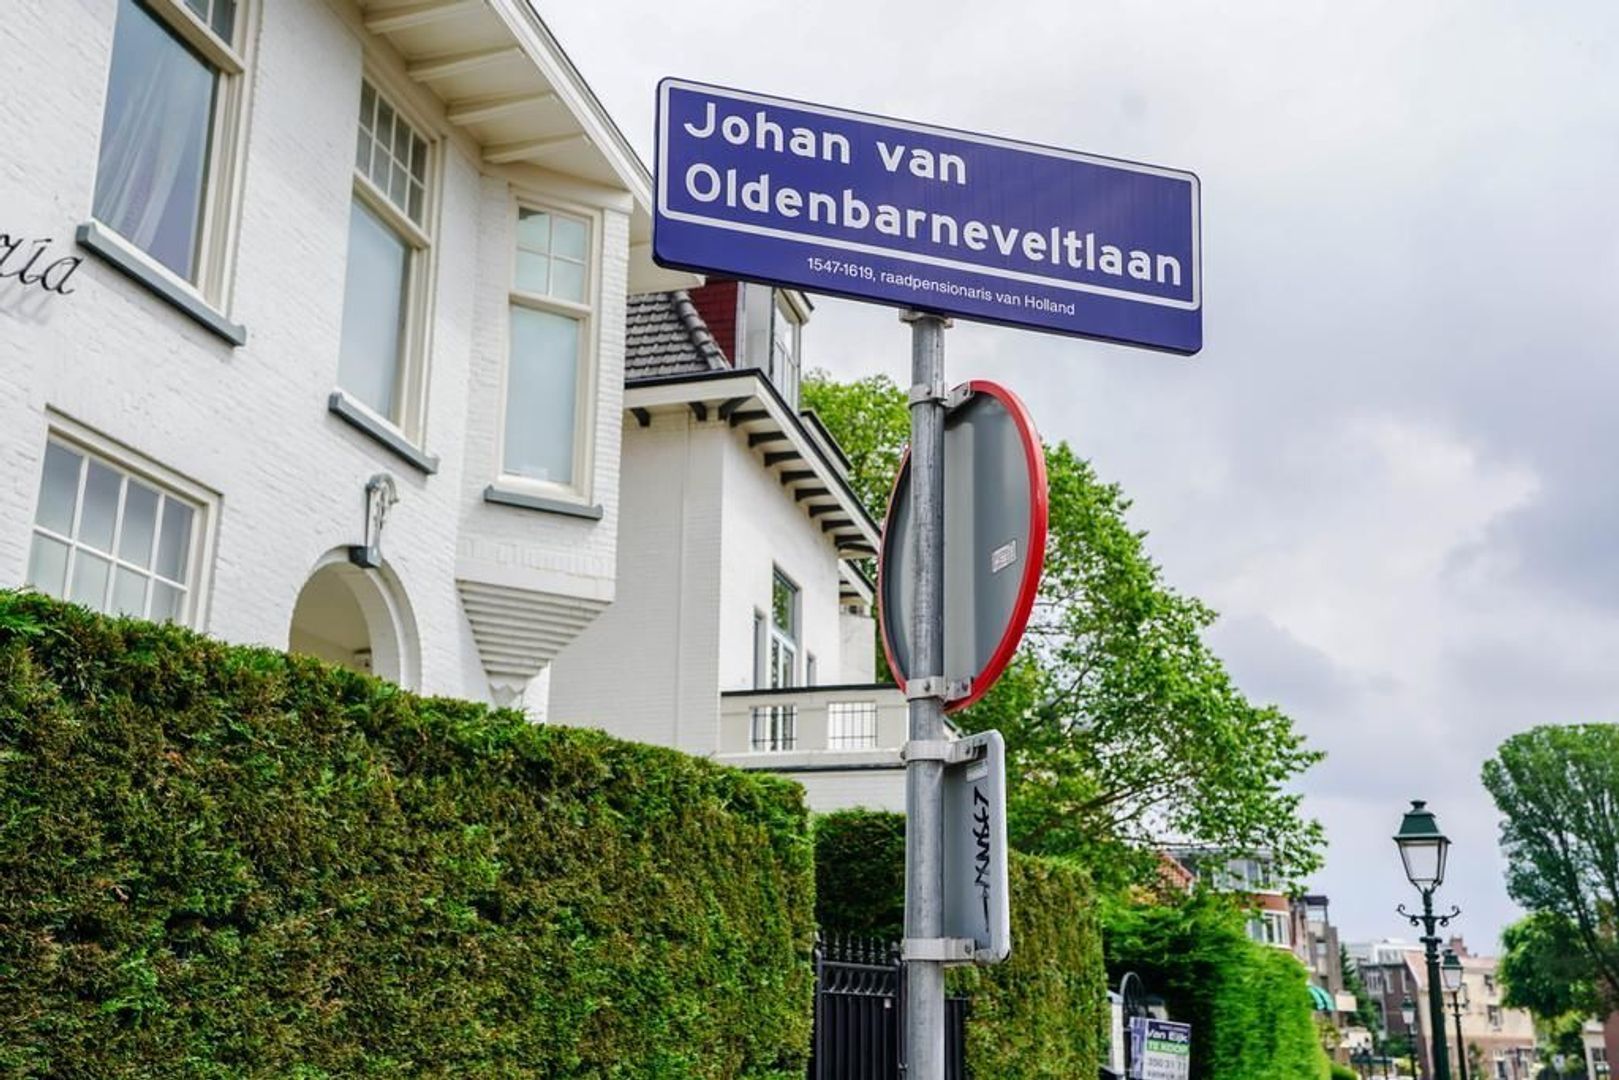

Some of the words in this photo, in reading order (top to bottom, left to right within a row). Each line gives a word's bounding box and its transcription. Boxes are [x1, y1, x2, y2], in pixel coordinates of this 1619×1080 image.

[684, 102, 851, 165] Johan
[876, 140, 967, 185] van
[684, 162, 1182, 287] Oldenbarneveltlaan
[807, 257, 876, 282] 1547-1619,
[880, 270, 993, 301] raadpensionaris
[995, 292, 1021, 306] van
[1024, 294, 1075, 315] Holland
